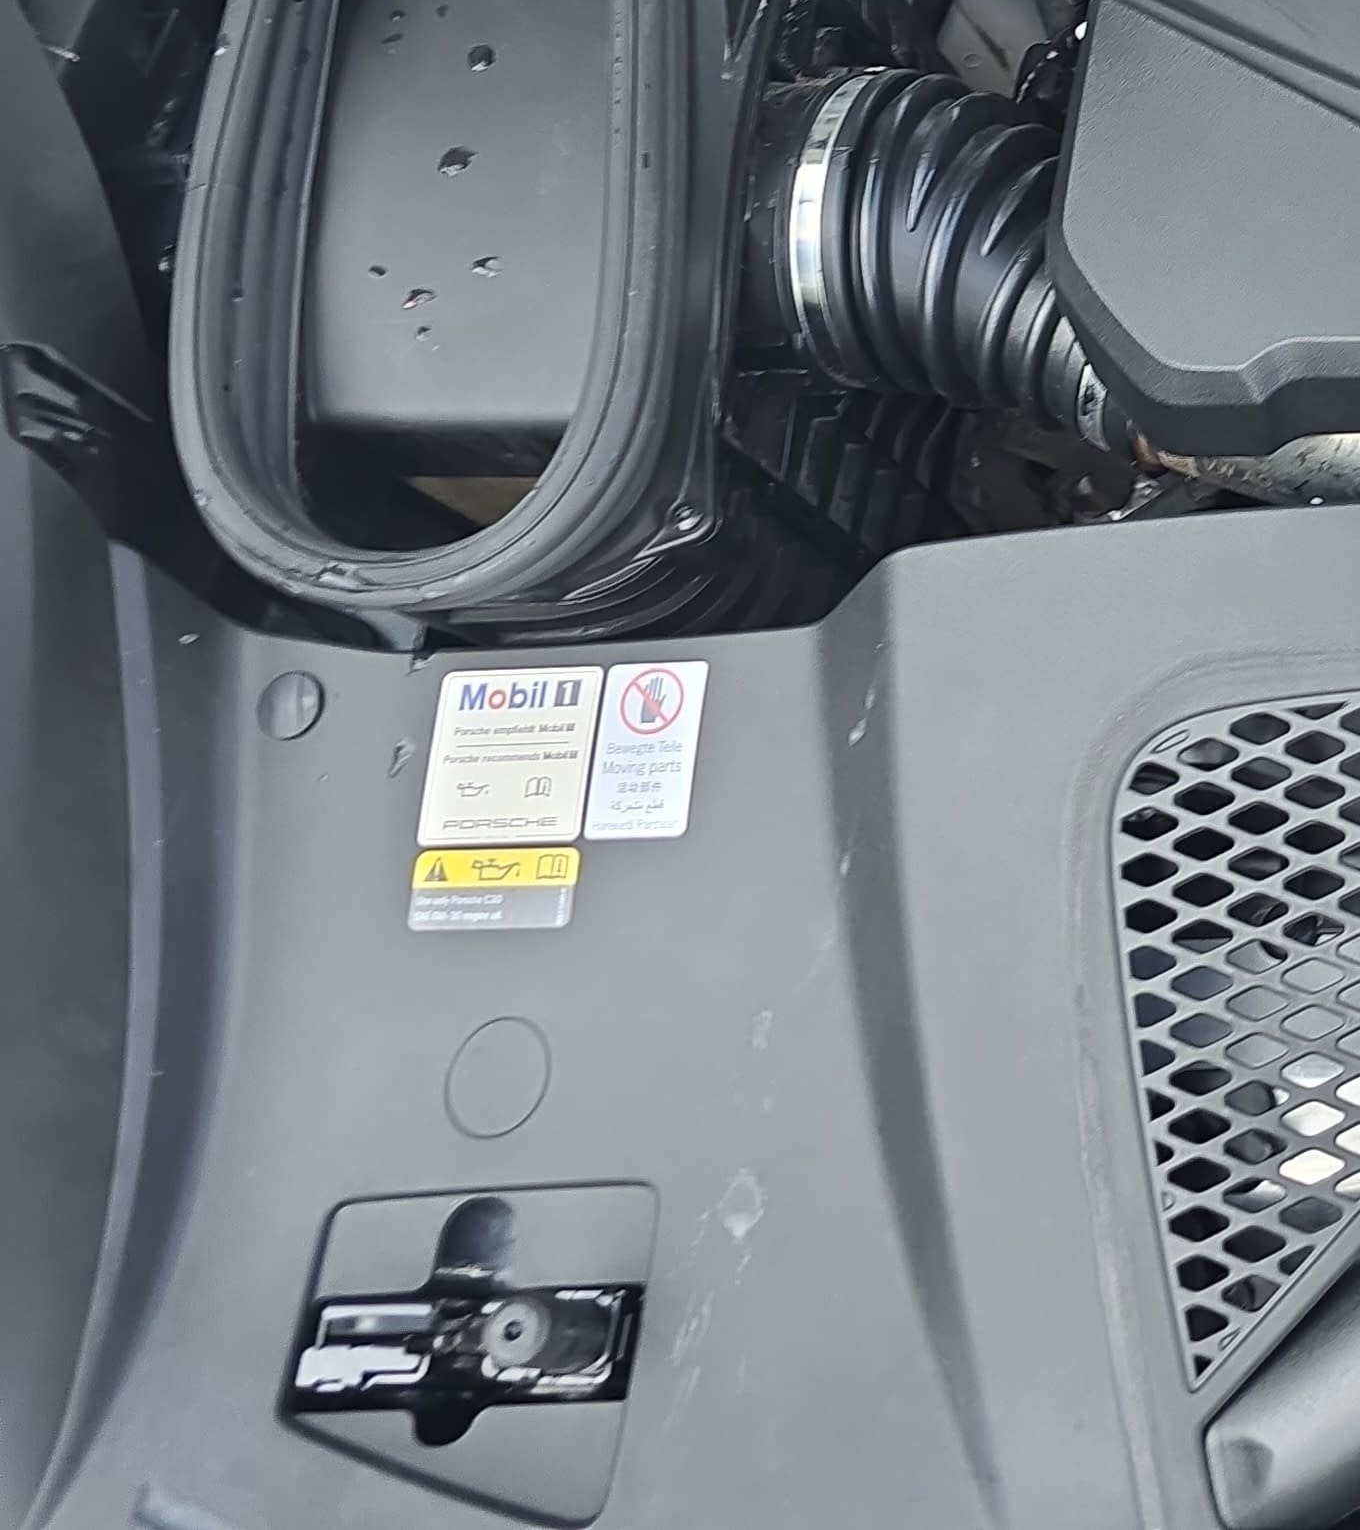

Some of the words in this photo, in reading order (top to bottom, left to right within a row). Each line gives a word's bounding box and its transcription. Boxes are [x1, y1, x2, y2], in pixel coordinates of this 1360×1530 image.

[458, 680, 549, 711] Mobil
[554, 679, 583, 708] 1
[601, 760, 647, 776] Moving
[648, 759, 682, 776] parts
[442, 816, 559, 831] PORSCHE
